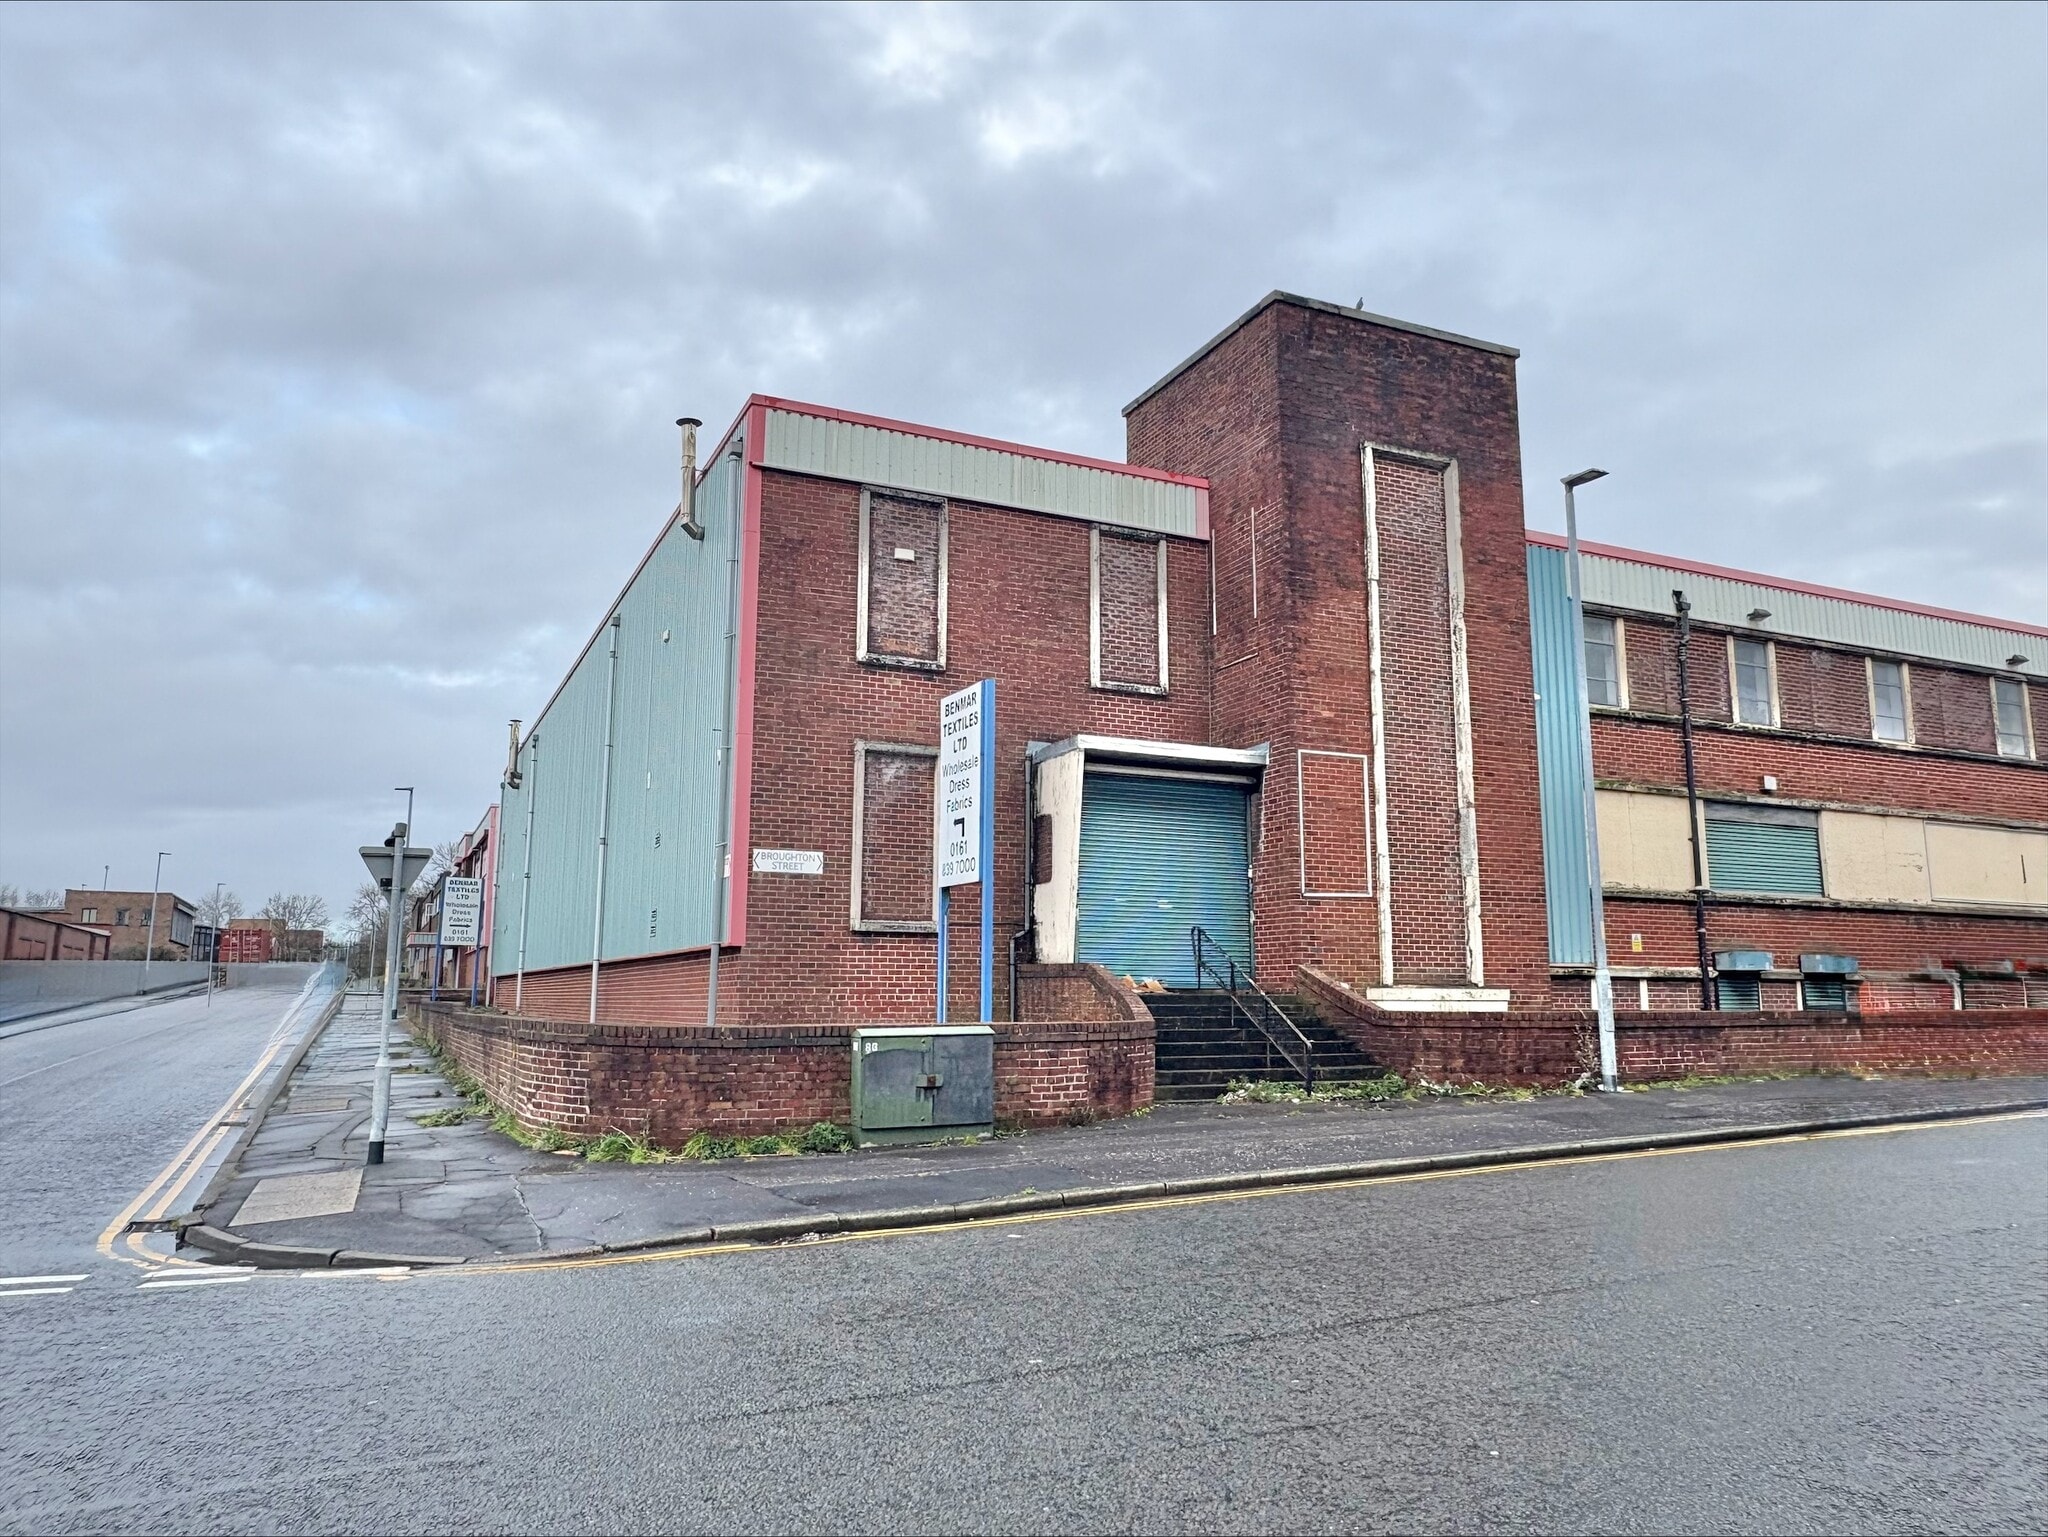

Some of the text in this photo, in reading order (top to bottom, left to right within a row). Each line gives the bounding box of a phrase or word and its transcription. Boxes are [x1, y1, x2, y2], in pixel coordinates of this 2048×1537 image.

[945, 692, 977, 718] BENMAR
[943, 711, 979, 738] TEXTILES
[953, 736, 968, 754] LTD
[942, 755, 979, 778] Wholesale
[949, 778, 970, 794] Dress
[946, 796, 973, 814] Fabrics
[761, 852, 816, 862] BROUGHTON
[950, 840, 968, 857] 0161
[772, 862, 804, 871] STREET
[942, 857, 976, 877] 839 7000
